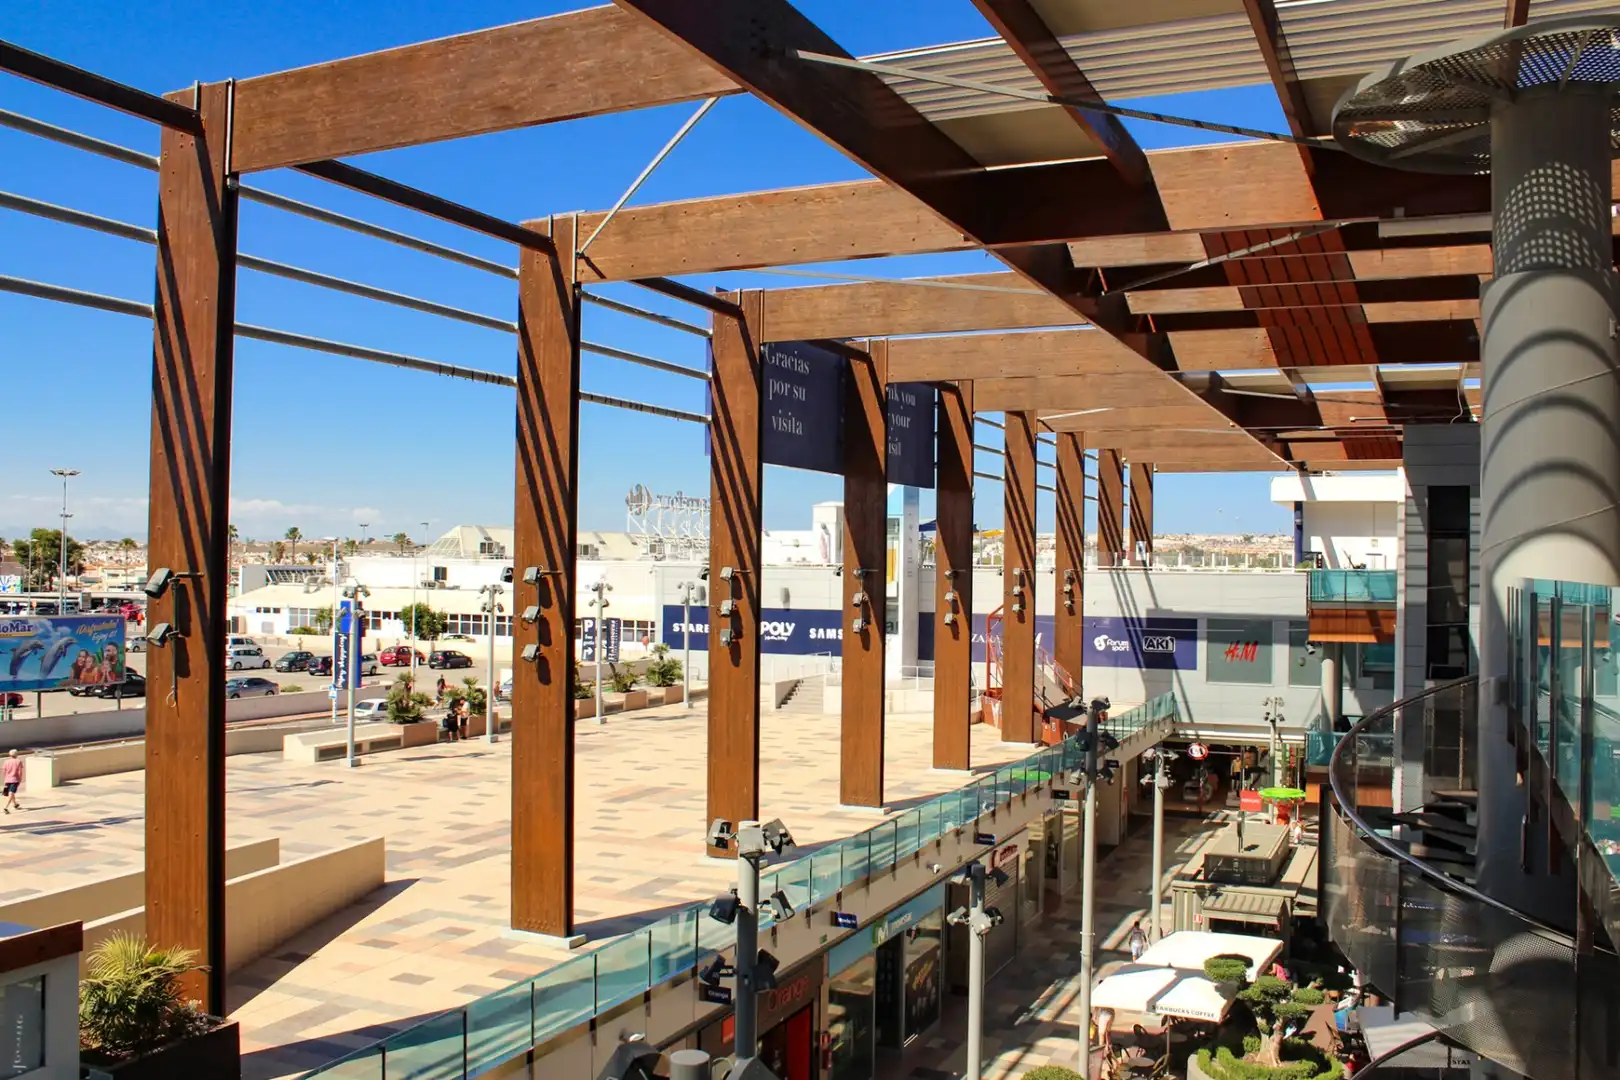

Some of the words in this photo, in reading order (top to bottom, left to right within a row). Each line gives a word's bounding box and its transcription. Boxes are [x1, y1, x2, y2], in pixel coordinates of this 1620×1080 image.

[765, 343, 810, 374] Gracias
[768, 379, 790, 400] por
[793, 385, 806, 401] su
[772, 408, 803, 435] visita
[891, 412, 911, 431] your
[888, 436, 901, 456] isit
[0, 621, 33, 632] oMar
[584, 619, 594, 632] P
[761, 621, 795, 636] POLY
[809, 628, 843, 640] SAMS
[1224, 640, 1259, 663] H&M
